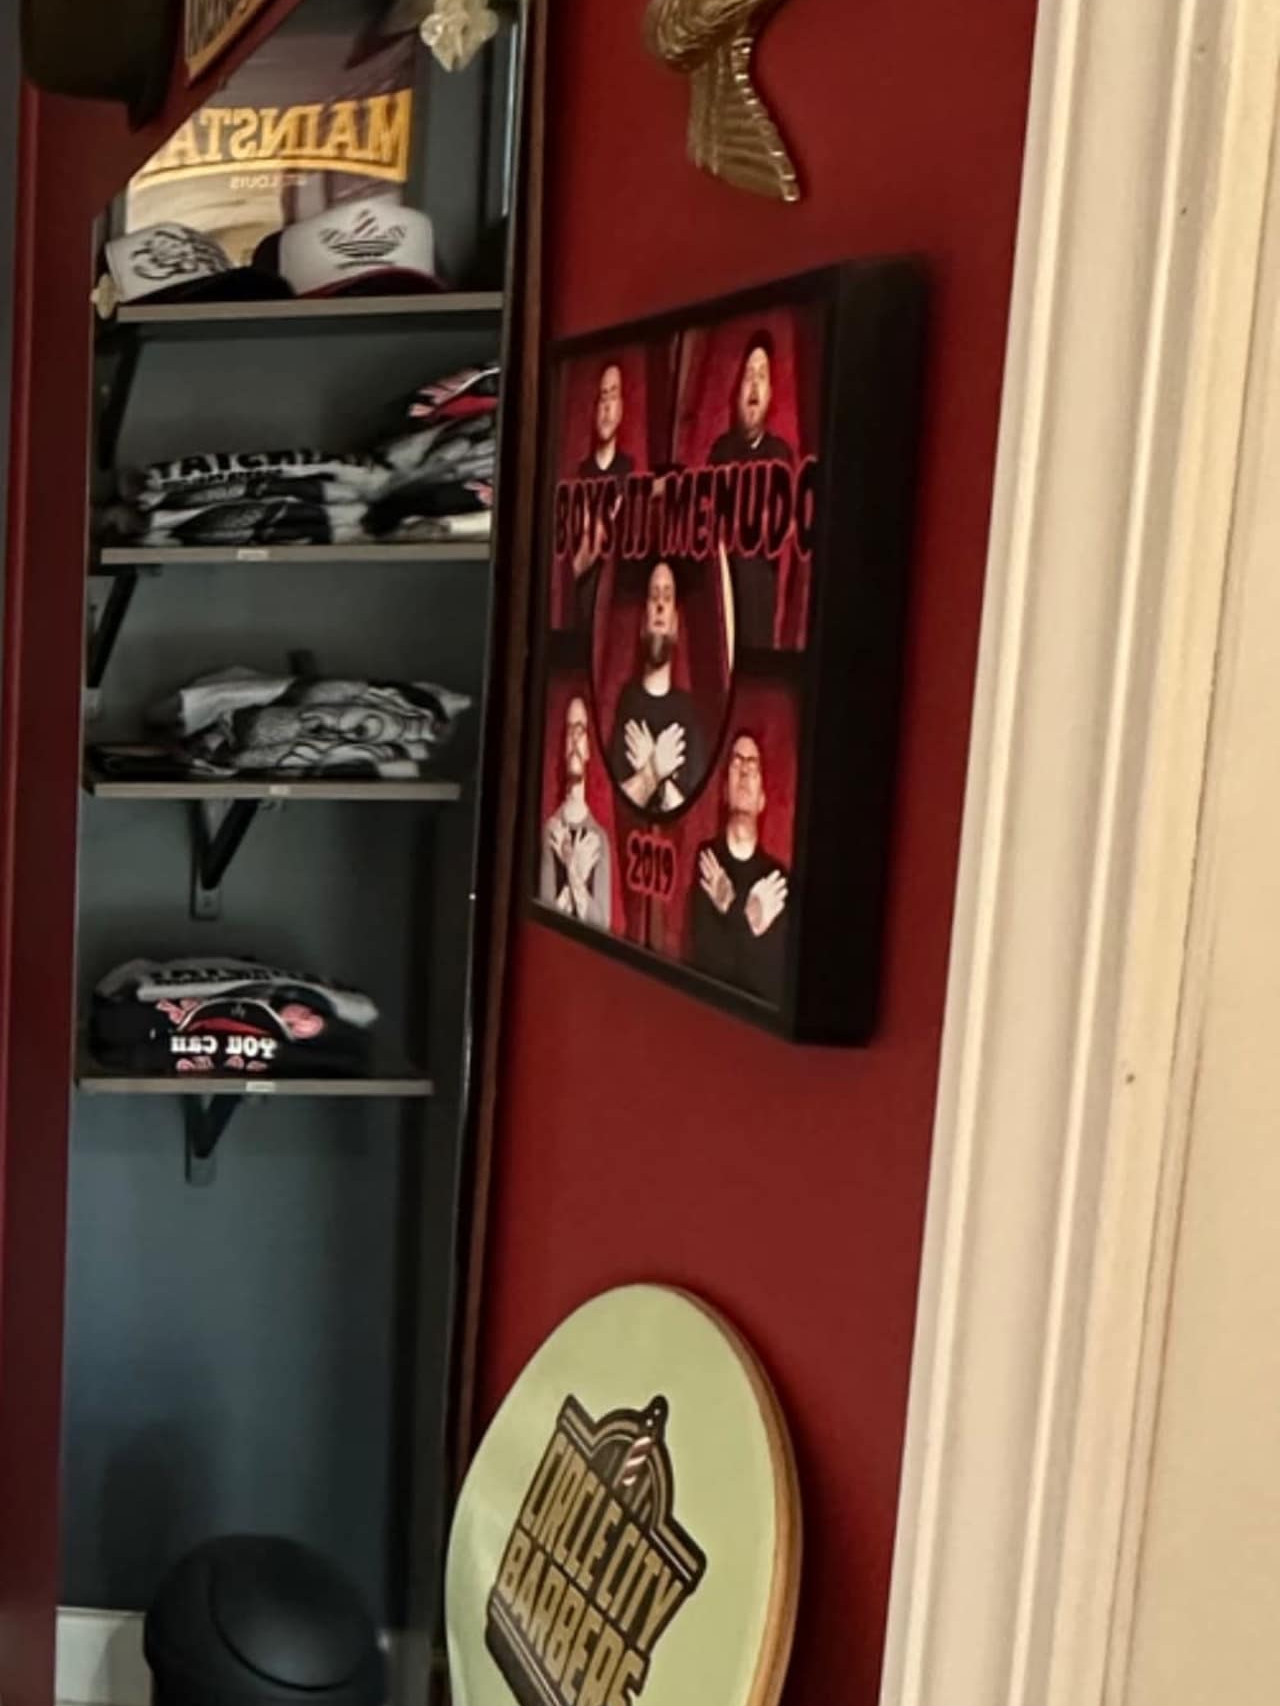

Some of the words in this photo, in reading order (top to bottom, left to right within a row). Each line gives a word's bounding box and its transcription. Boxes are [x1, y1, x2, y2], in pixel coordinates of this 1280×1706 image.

[553, 475, 619, 560] BOYS
[626, 829, 677, 900] 2019
[520, 1430, 625, 1592] CIRCLE
[594, 1520, 685, 1652] CITY
